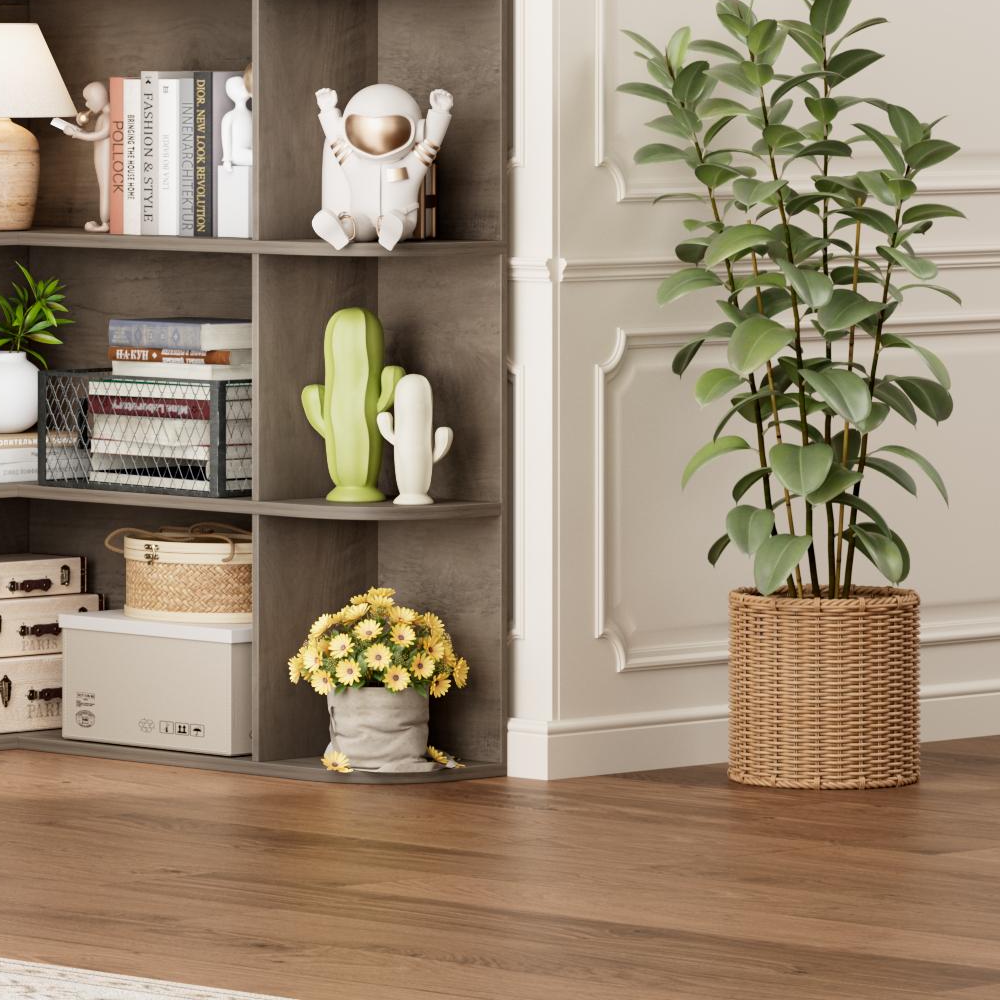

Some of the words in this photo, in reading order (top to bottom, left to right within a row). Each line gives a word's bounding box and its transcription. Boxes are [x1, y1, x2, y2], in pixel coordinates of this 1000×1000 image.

[127, 114, 136, 144] BRINGING
[144, 93, 154, 157] FASHION
[196, 109, 206, 134] NEW
[112, 120, 124, 193] POLLOCK
[127, 146, 136, 158] THE
[196, 136, 206, 165] LOOK
[127, 160, 136, 182] HOUSE
[144, 162, 154, 173] &
[182, 102, 194, 232] INNENARCHITEKTUR
[127, 182, 136, 200] HOME
[144, 177, 154, 223] STYLE
[196, 166, 206, 232] REVOLUTION
[22, 638, 58, 650] PARIS
